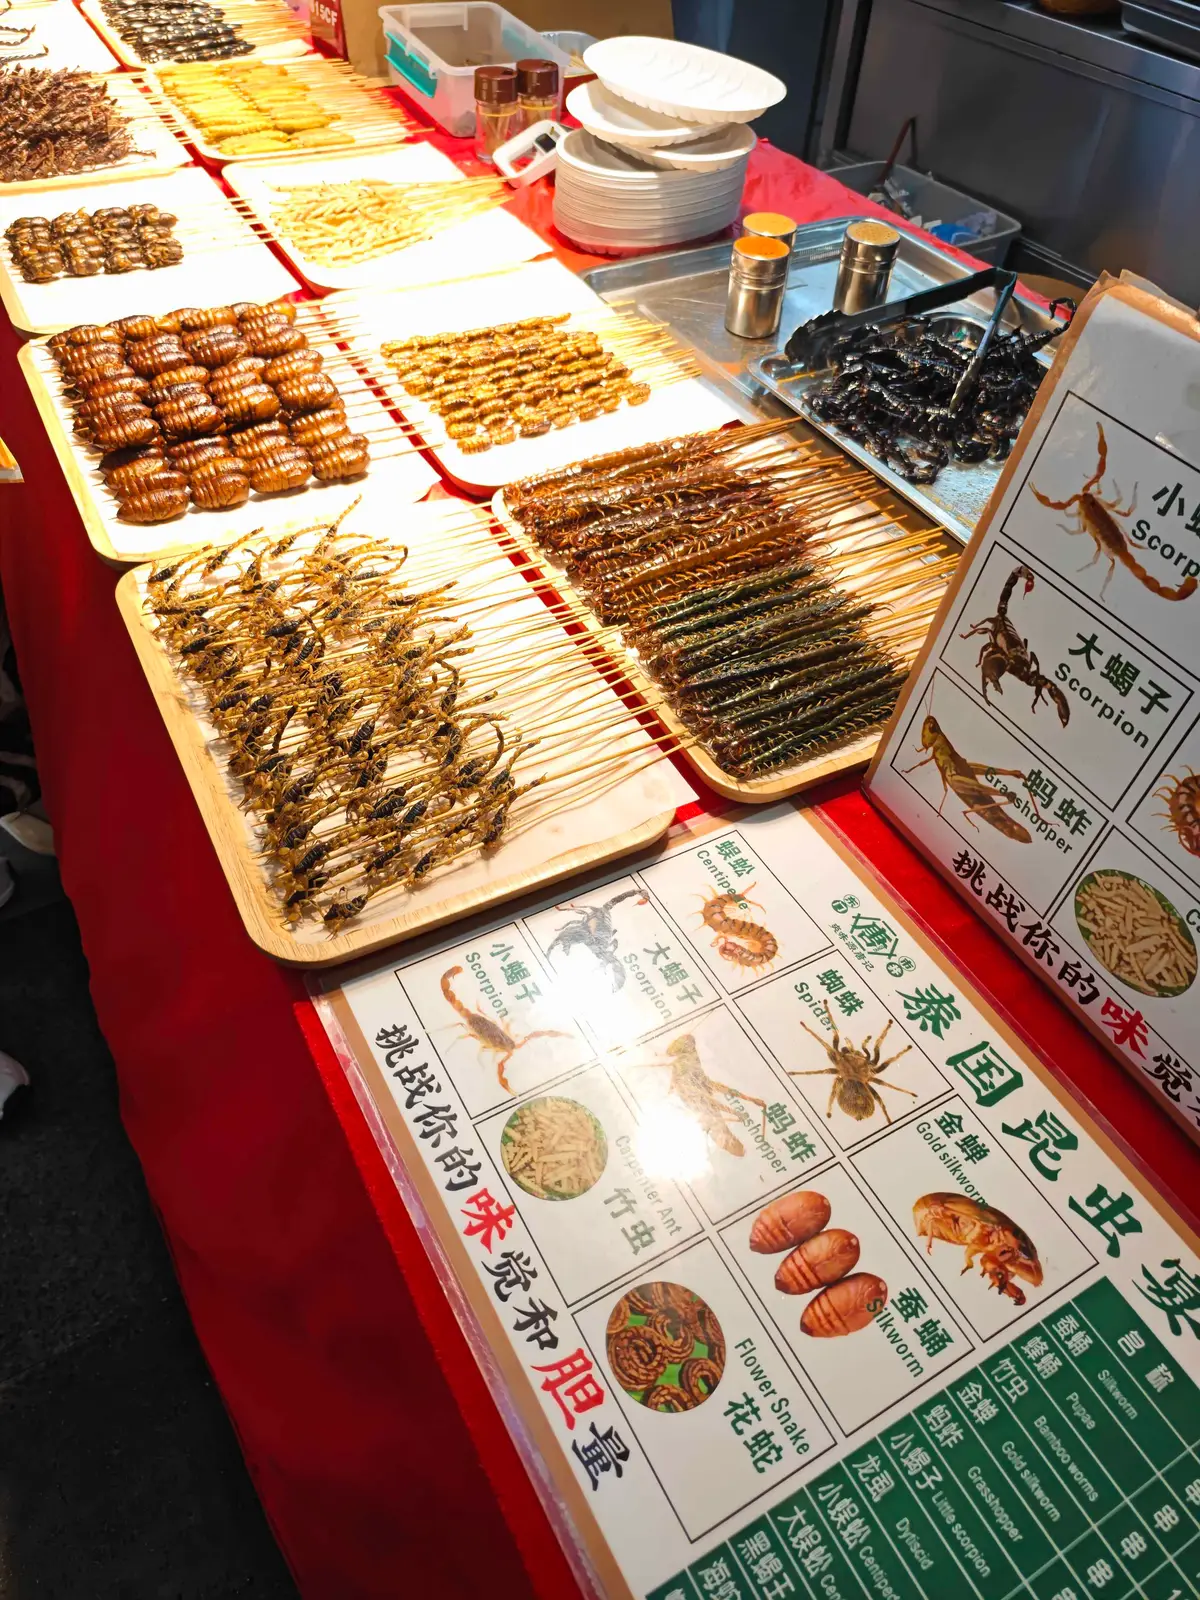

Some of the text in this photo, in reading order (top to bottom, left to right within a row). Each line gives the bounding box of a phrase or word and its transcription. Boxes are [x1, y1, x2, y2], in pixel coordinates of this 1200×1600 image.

[1054, 662, 1150, 749] Scorpion
[1068, 633, 1172, 715] 大蝎子
[984, 766, 1073, 854] Grashopper
[1022, 768, 1093, 836] 蚂蚱
[715, 840, 756, 878] 蜈蚣
[466, 951, 509, 1018] Scorpion
[489, 942, 544, 1004] 小蝎子
[623, 953, 673, 1020] Scorpion
[643, 942, 704, 1005] 大蝎子
[816, 968, 865, 1017] 蜘蛛
[762, 1102, 817, 1164] 蚂蚱
[916, 1121, 947, 1153] Gold
[933, 1111, 990, 1165] 金蝉
[615, 1135, 683, 1237] Carpenter Ant
[603, 1187, 656, 1256] 竹虫
[375, 1023, 631, 1492] 挑战你的味觉和胆量
[866, 1297, 925, 1378] Silkworm
[890, 1287, 954, 1358] 蚕蛹
[1052, 1314, 1094, 1357] 蚕蛹
[991, 1357, 1029, 1404] 竹虫
[1021, 1335, 1062, 1380] 蜂蛹
[734, 1337, 810, 1455] Flower Snake
[923, 1404, 964, 1449] 蚂蚱
[957, 1381, 999, 1425] 金蝉
[1066, 1391, 1096, 1430] Pupae
[1097, 1368, 1138, 1420] Silkworm
[723, 1392, 783, 1474] 花蛇
[890, 1433, 944, 1490] 小蝎子
[1033, 1414, 1099, 1502] Bamboo worms
[852, 1453, 895, 1503] 龙虱
[967, 1466, 1024, 1543] Grasshopper
[1001, 1440, 1061, 1522] Gold silkworm
[777, 1505, 834, 1578] 大蜈蚣
[818, 1483, 872, 1550] 小蜈蚣
[896, 1516, 934, 1570] Dytiscid
[931, 1490, 992, 1578] Little scorpion
[1120, 1531, 1147, 1560] 串
[1153, 1504, 1180, 1532] 串
[738, 1530, 796, 1600] 黑蝎王
[1087, 1559, 1113, 1588] 串
